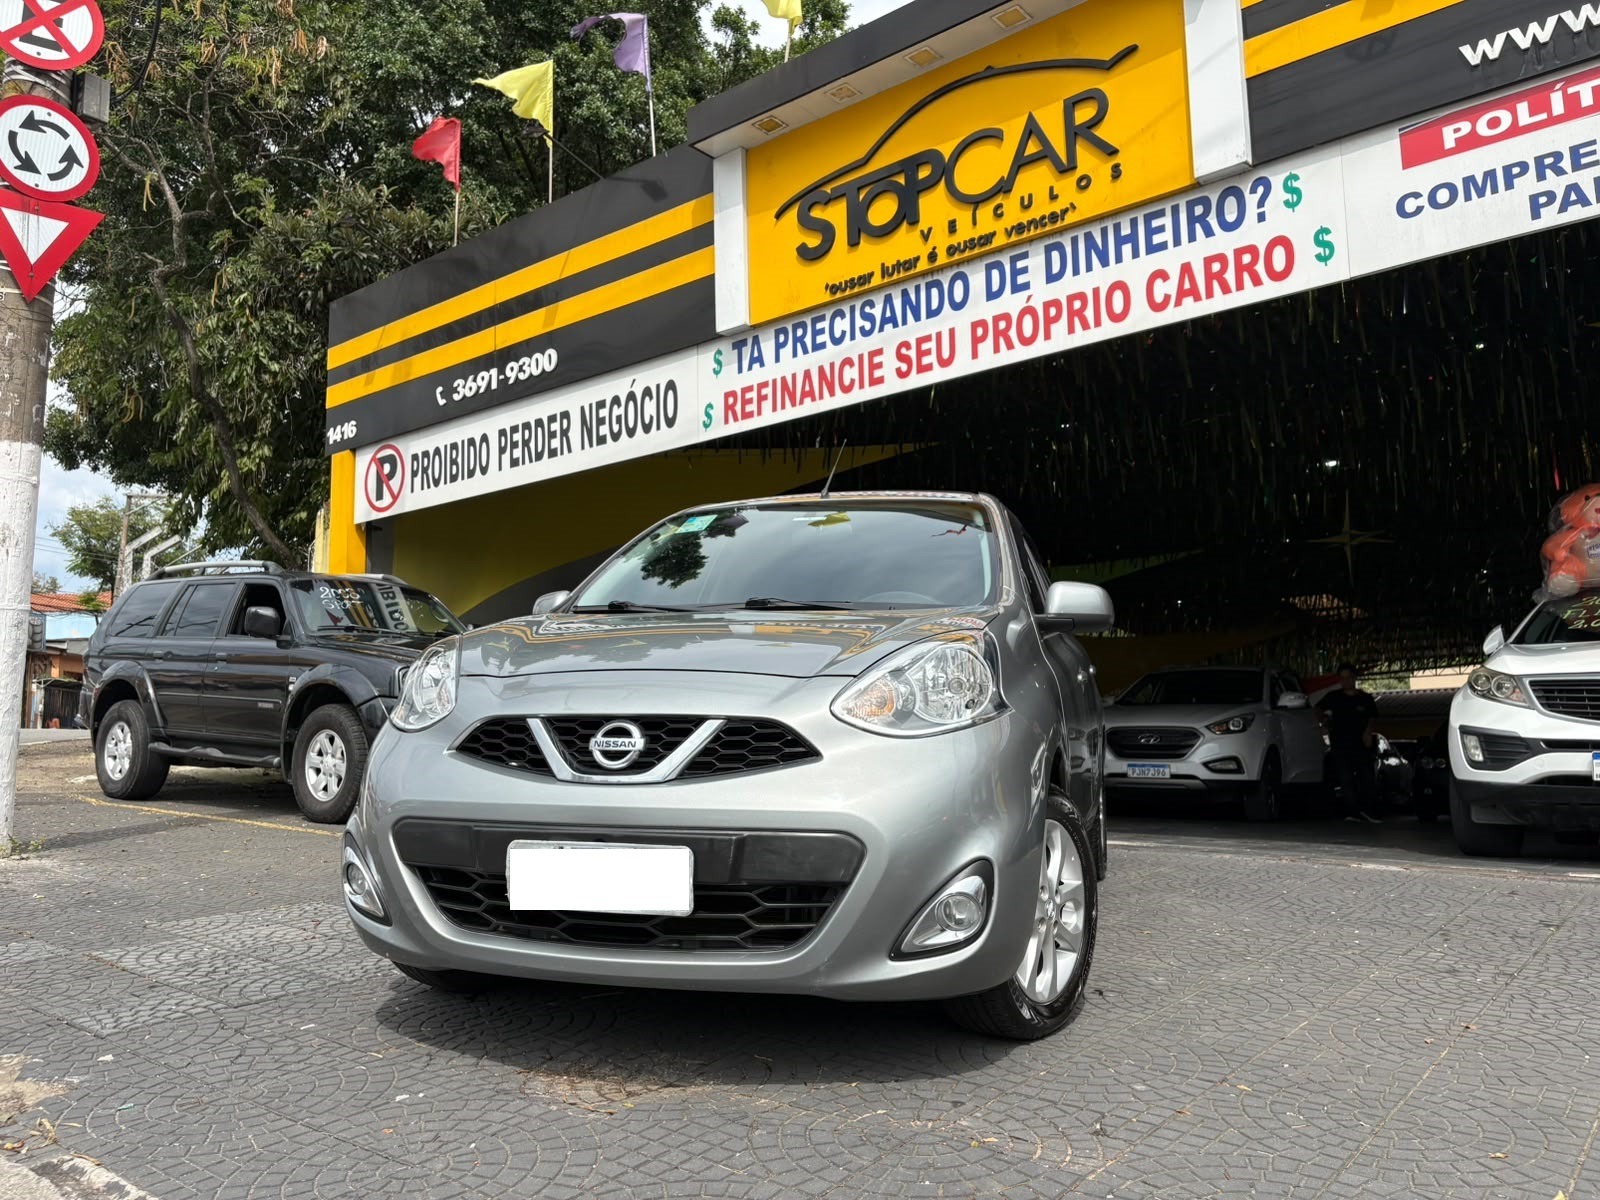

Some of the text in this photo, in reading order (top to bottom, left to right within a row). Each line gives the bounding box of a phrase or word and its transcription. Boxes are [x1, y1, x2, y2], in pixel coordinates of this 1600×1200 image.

[1441, 78, 1600, 150] POLÍT
[1396, 139, 1600, 219] COMPRE
[732, 334, 766, 375] TA
[774, 270, 970, 364] PRECISANDO
[984, 250, 1031, 302] DE
[1044, 175, 1272, 285] DINHEIRO?
[880, 252, 920, 281] lutar
[927, 246, 938, 263] é
[946, 229, 997, 256] ousar
[723, 347, 885, 425] REFINANCIE
[895, 327, 956, 379] SEU
[970, 279, 1132, 360] PRÓPRIO
[1145, 234, 1295, 313] CARRO
[451, 348, 559, 402] 3691-9300
[326, 420, 357, 446] 1416
[410, 432, 490, 494] PROIBIDO
[498, 410, 572, 472] PERDER
[580, 378, 679, 449] NEGÓCIO
[593, 740, 637, 748] NISSAN
